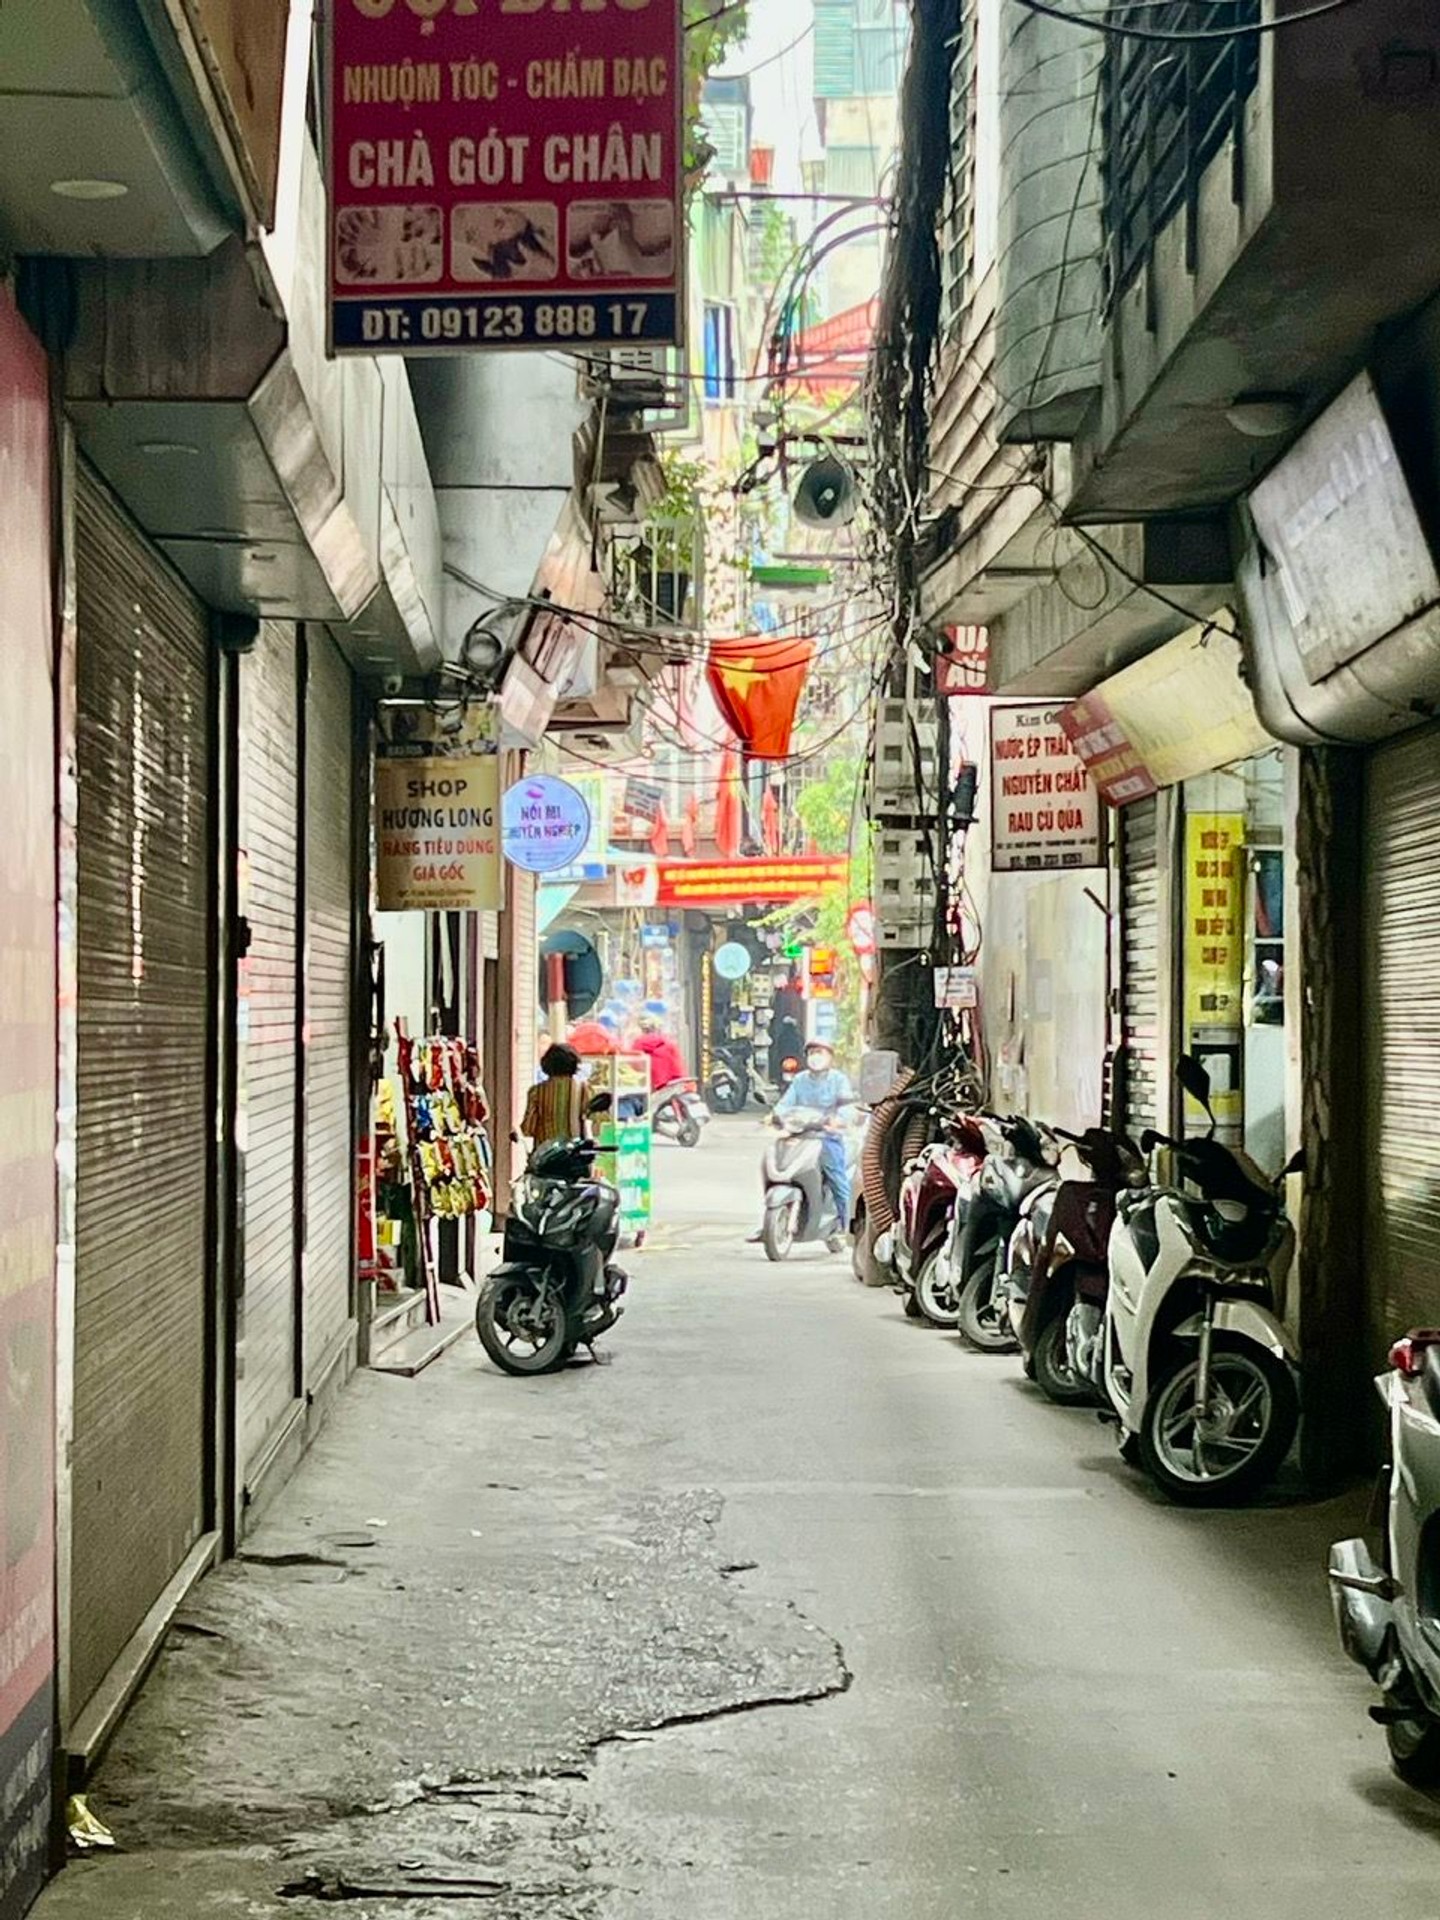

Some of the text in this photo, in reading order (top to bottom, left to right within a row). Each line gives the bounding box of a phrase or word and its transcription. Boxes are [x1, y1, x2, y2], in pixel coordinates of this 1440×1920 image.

[343, 56, 440, 112] NHUỘM
[450, 54, 499, 101] TÓC
[613, 58, 668, 106] BẠC
[348, 121, 663, 188] CHÀ GÓT CHÂN
[421, 305, 525, 340] 09123
[535, 304, 597, 337] 888
[607, 303, 649, 335] 17
[407, 780, 468, 798] SHOP
[449, 808, 493, 828] LONG
[1008, 811, 1033, 834] RAU
